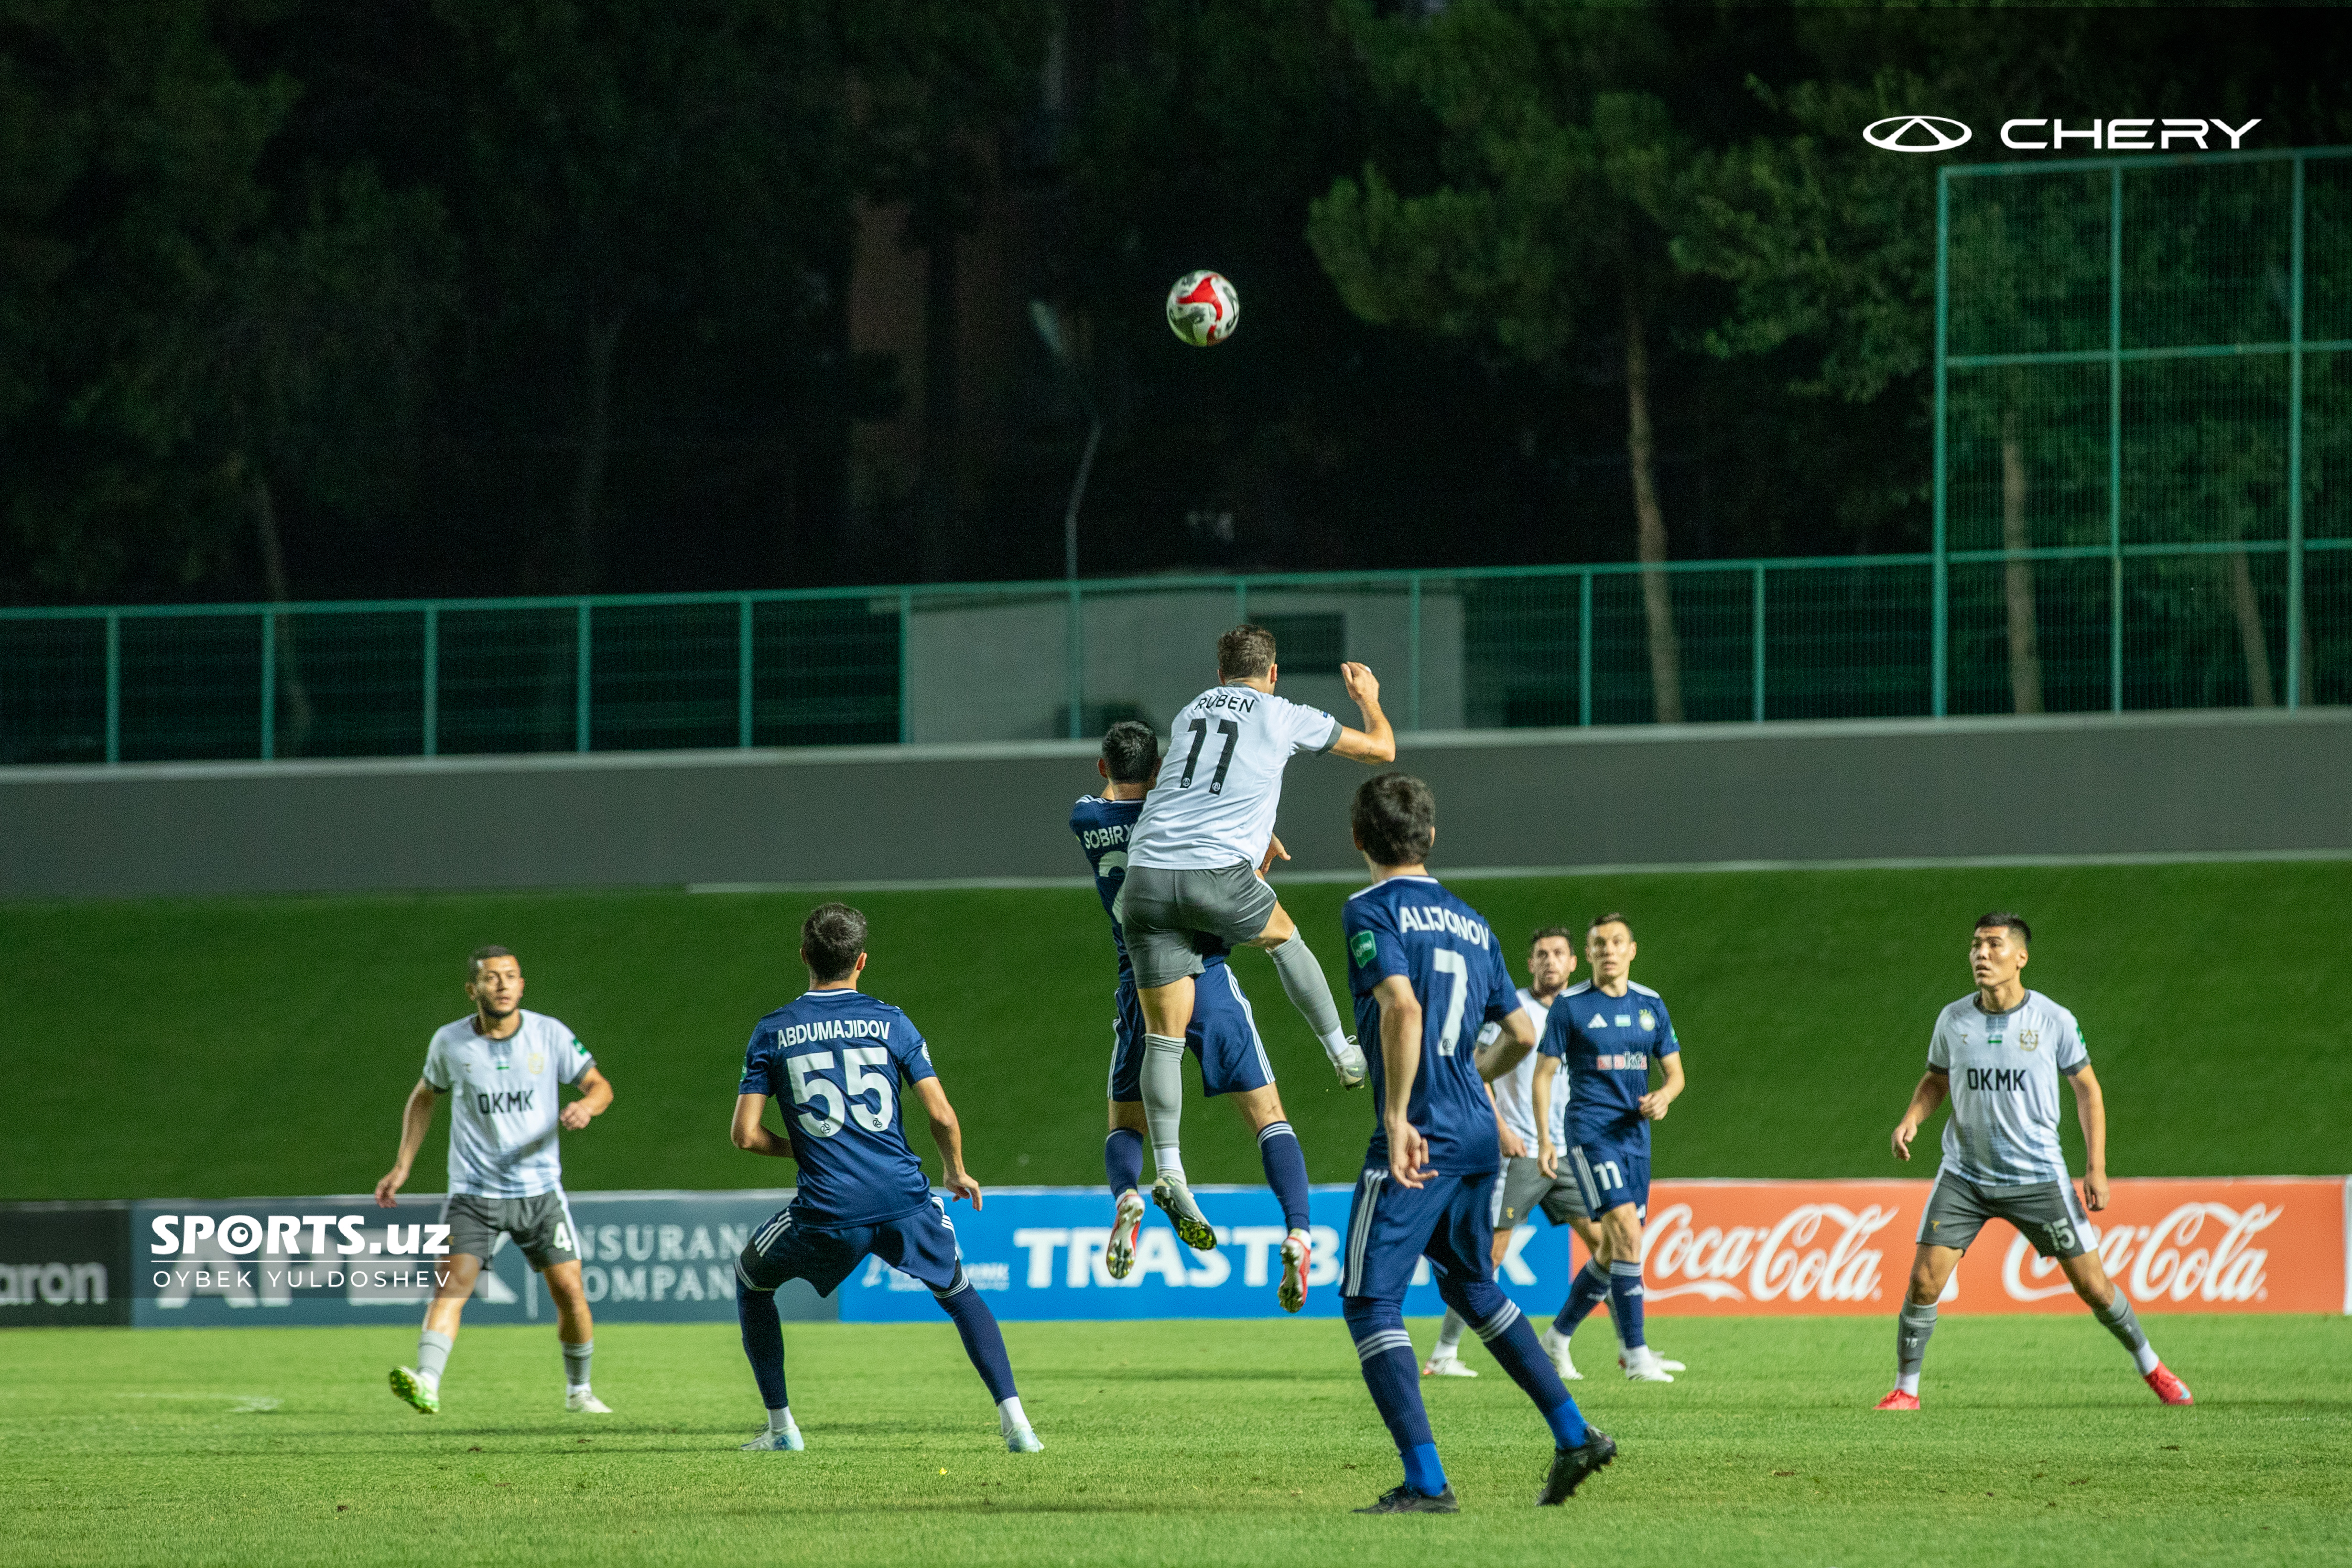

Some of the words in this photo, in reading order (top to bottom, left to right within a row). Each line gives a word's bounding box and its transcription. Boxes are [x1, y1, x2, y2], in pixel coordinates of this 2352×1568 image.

[1194, 694, 1255, 713] RUBEN
[1180, 718, 1239, 795] 11
[1400, 907, 1489, 950] ALIJONOV
[1434, 948, 1468, 1056] 7
[778, 1020, 890, 1049] ABDUMAJIDOV
[786, 1047, 893, 1137] 55
[1967, 1068, 2026, 1092] OKMK
[478, 1090, 534, 1114] OKMK
[1593, 1161, 1624, 1190] 11
[553, 1222, 572, 1251] 4
[575, 1223, 756, 1262] NSURAN
[2043, 1217, 2075, 1251] 15
[155, 1229, 519, 1308] APE
[1013, 1225, 1538, 1288] TRASTBK
[582, 1265, 736, 1302] OMPAN
